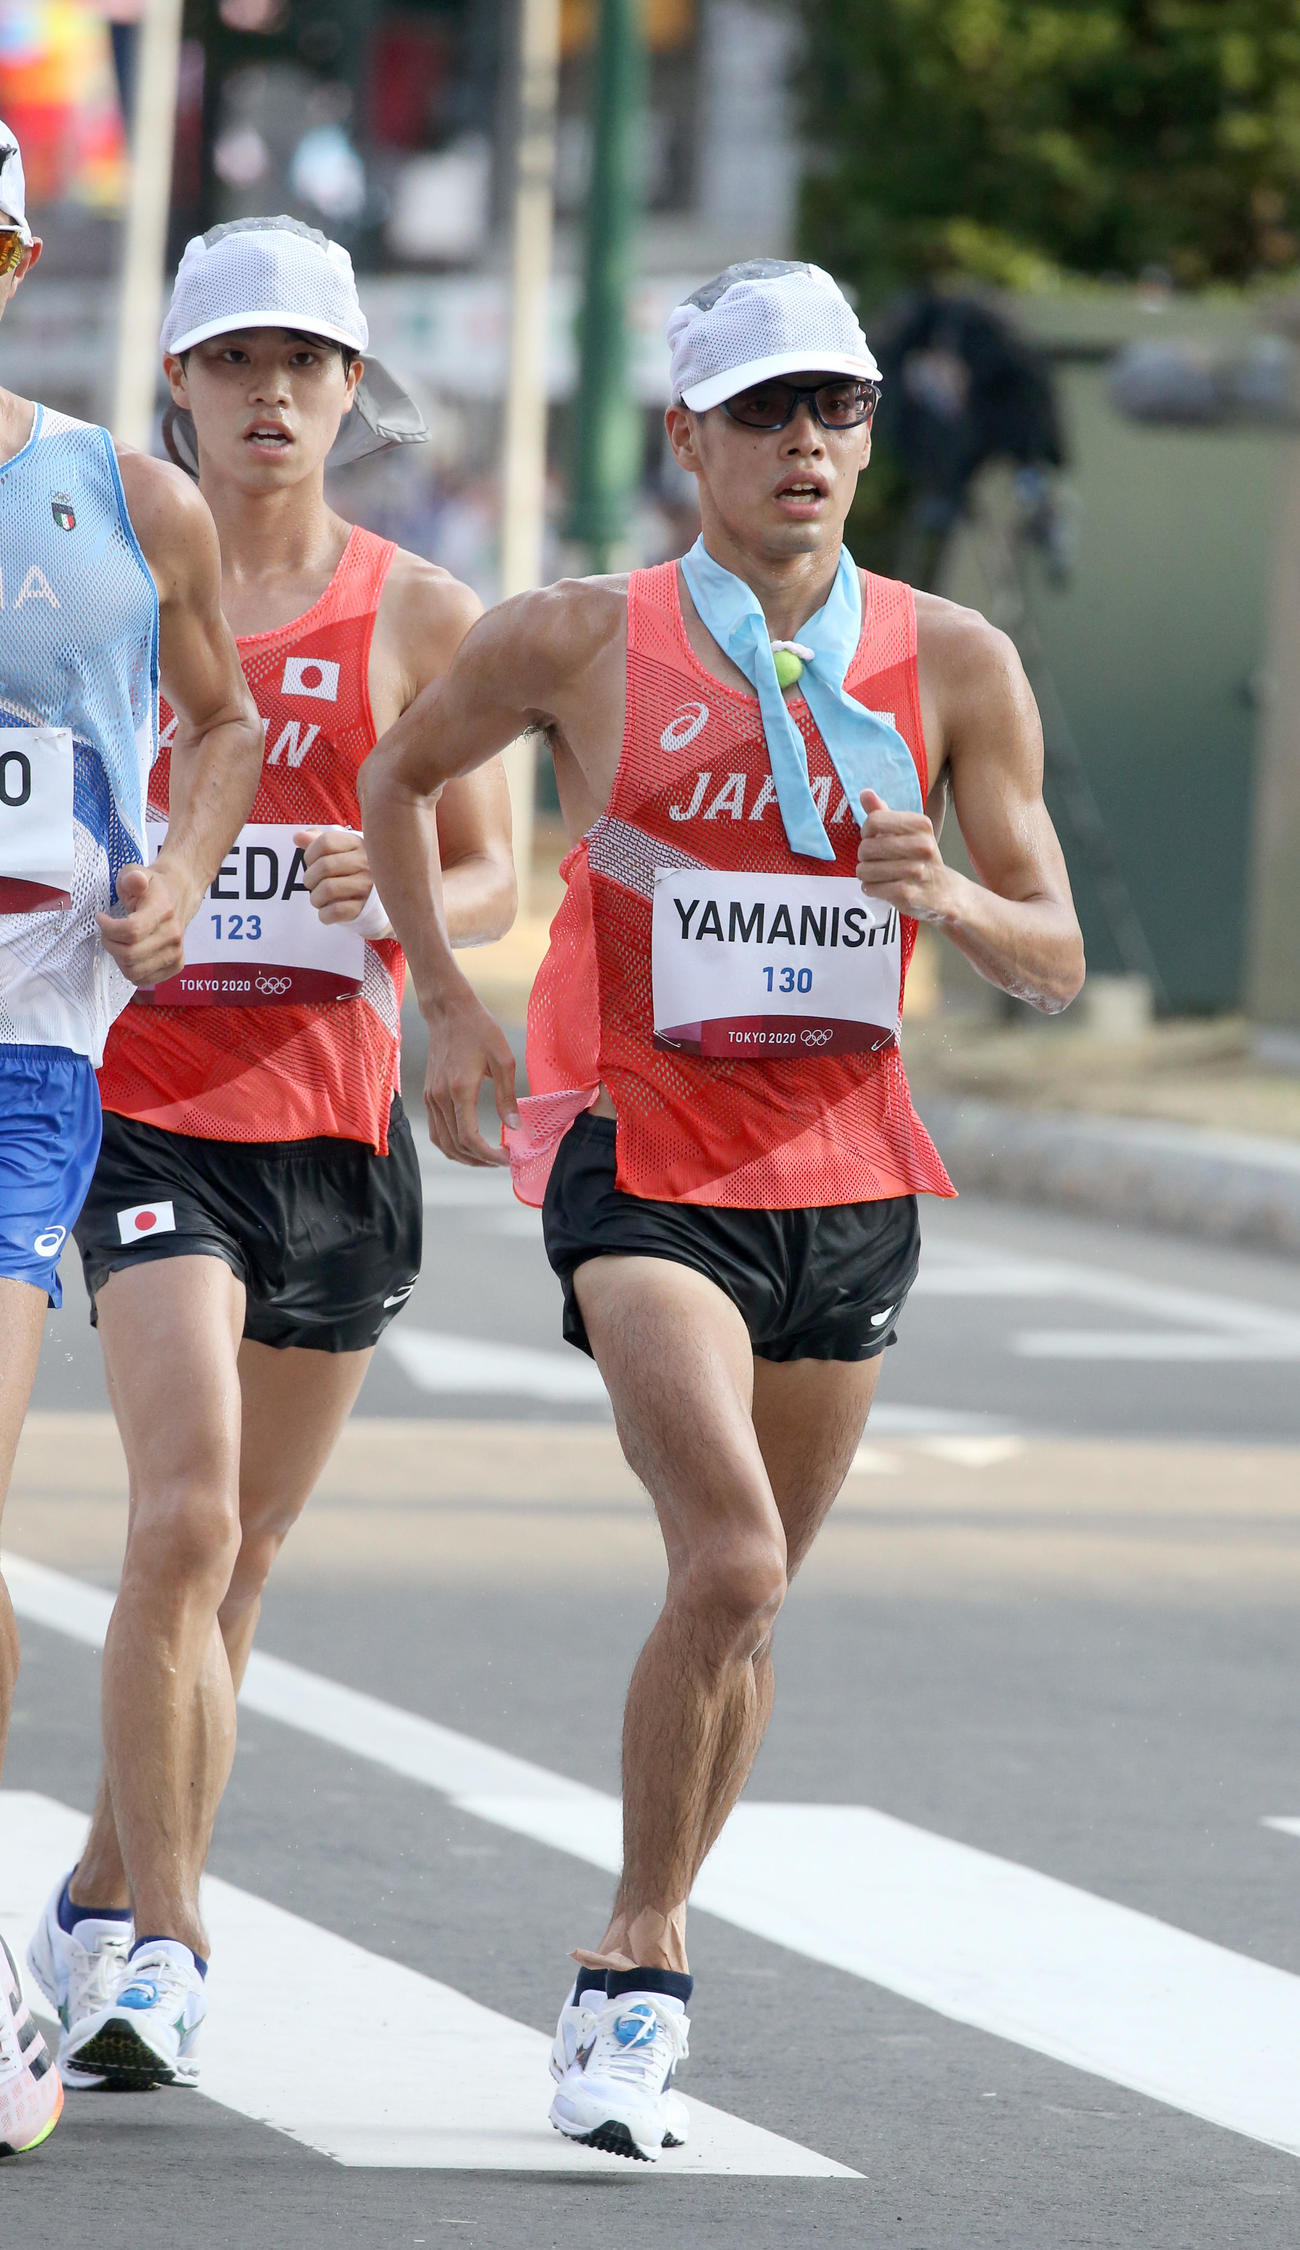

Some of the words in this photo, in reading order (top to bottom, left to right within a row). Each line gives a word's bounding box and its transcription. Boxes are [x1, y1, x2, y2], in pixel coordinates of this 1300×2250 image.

[157, 845, 311, 900] EDA
[211, 914, 262, 940] 123
[674, 898, 897, 948] YAMANISHI
[180, 979, 219, 991] TOKYO
[221, 980, 251, 992] 2020
[762, 966, 813, 994] 130
[728, 1031, 766, 1043] TOKYO
[768, 1033, 797, 1045] 2020
